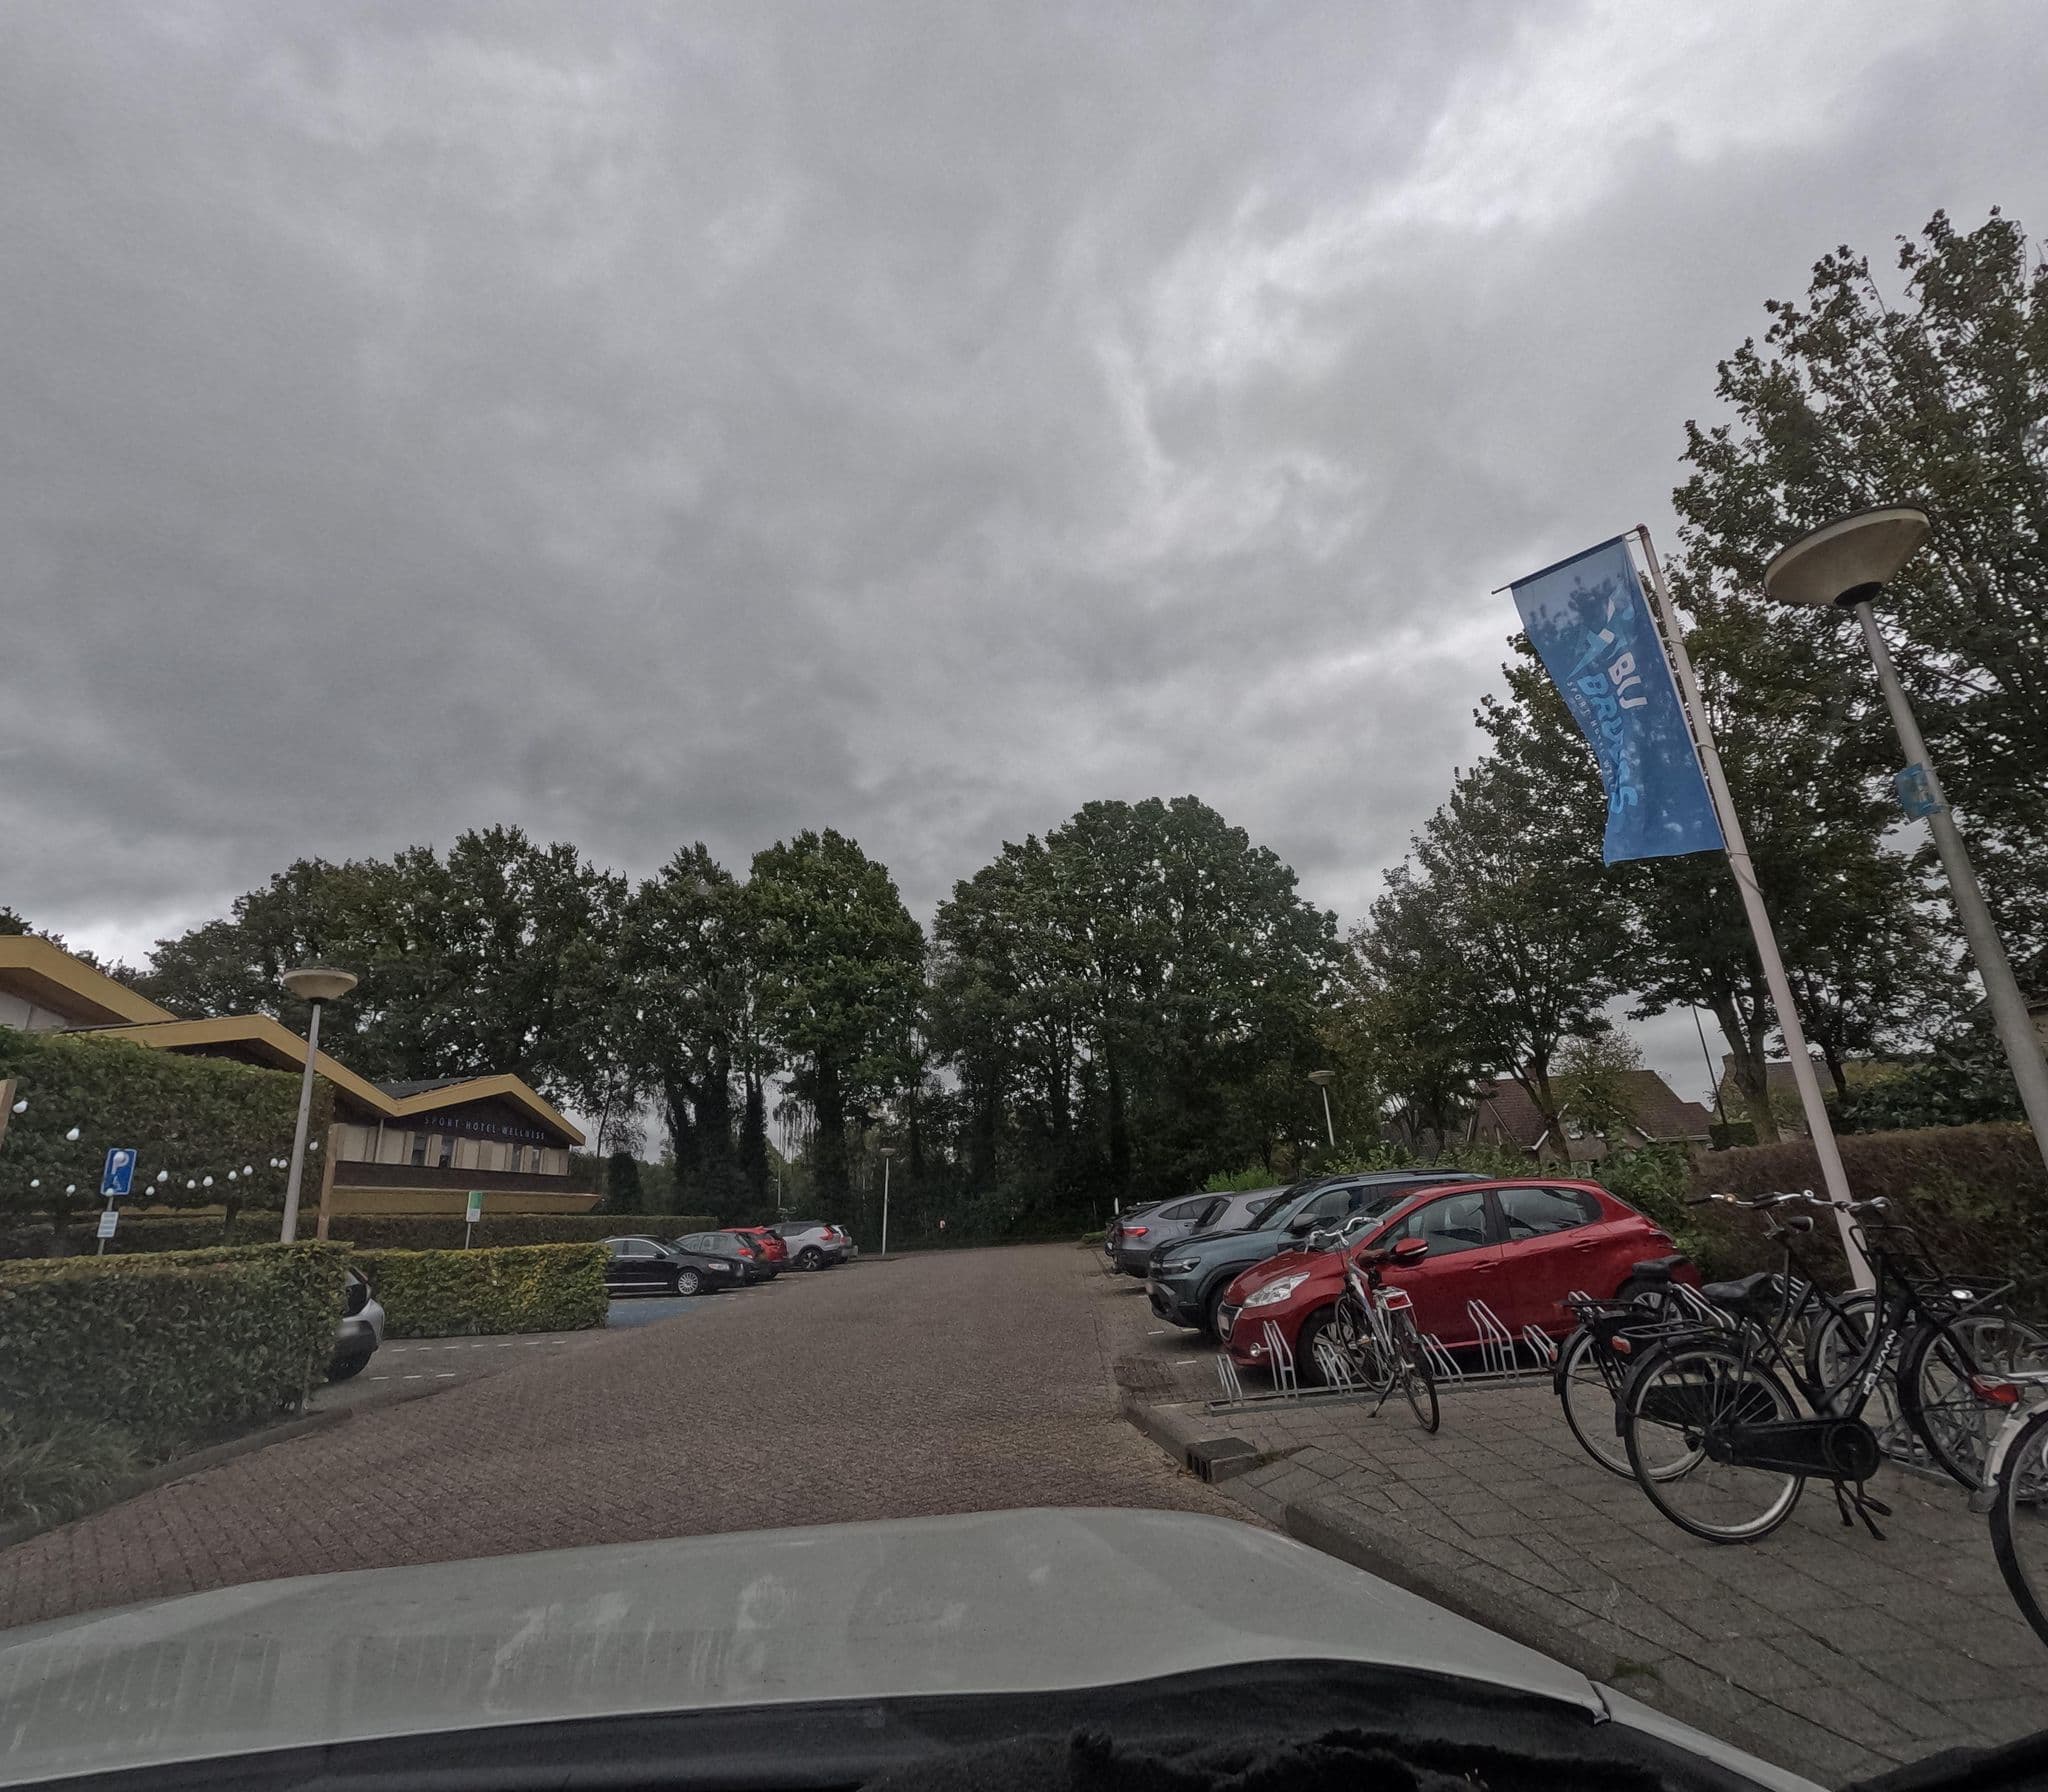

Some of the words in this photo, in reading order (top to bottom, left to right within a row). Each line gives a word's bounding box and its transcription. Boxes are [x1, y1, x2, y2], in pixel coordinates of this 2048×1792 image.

[1566, 680, 1591, 716] SPORT
[1607, 651, 1648, 709] BIJ
[424, 1117, 459, 1128] SPORT
[465, 1120, 496, 1134] HOTEL
[502, 1126, 545, 1140] WELLNESS
